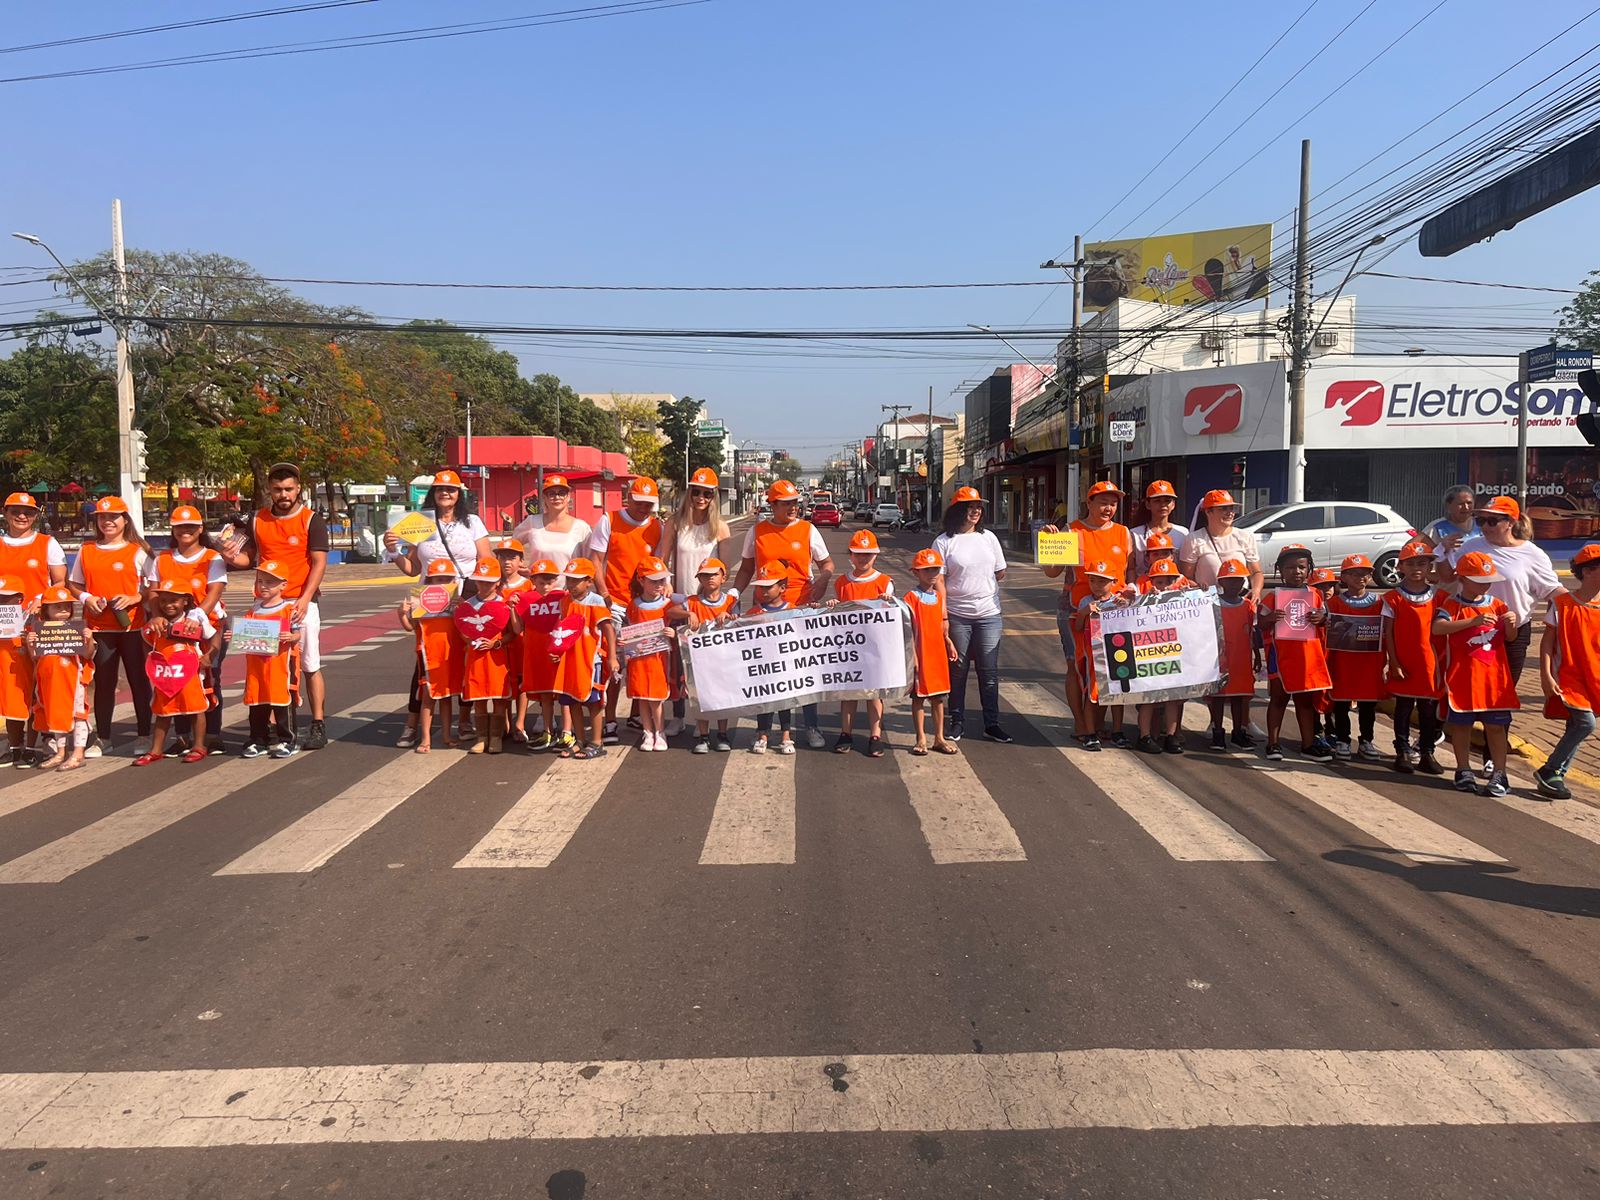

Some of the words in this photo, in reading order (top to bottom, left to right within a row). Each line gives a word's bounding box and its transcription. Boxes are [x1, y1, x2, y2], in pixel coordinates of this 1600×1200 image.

[1556, 357, 1567, 366] HAL
[1568, 357, 1591, 366] RONDON
[1386, 381, 1598, 419] EletroSom
[1512, 417, 1561, 429] Dpertando
[1565, 416, 1579, 426] Tal
[1476, 483, 1564, 498] Despeando
[529, 601, 561, 616] PAZ
[1102, 607, 1141, 620] RESPEITE
[1145, 606, 1152, 614] A
[1156, 598, 1209, 612] SINALIZAÇÃO
[1290, 602, 1298, 627] PARE
[1136, 617, 1147, 627] DE
[1154, 608, 1201, 624] TRÂNSITO
[691, 622, 795, 649] SECRETARIA
[805, 611, 896, 631] MUNICIPAL
[1133, 628, 1178, 645] PARE
[64, 641, 83, 649] pacto
[741, 647, 763, 661] DE
[778, 631, 867, 655] EDUCAÇÃO
[1135, 643, 1182, 658] ATENÇÃO
[155, 664, 184, 678] PAZ
[747, 660, 787, 677] EMEI
[794, 650, 860, 670] MATEUS
[1137, 660, 1182, 677] SIGA
[741, 675, 815, 699] VINICIUS
[822, 670, 864, 685] BRAZ
